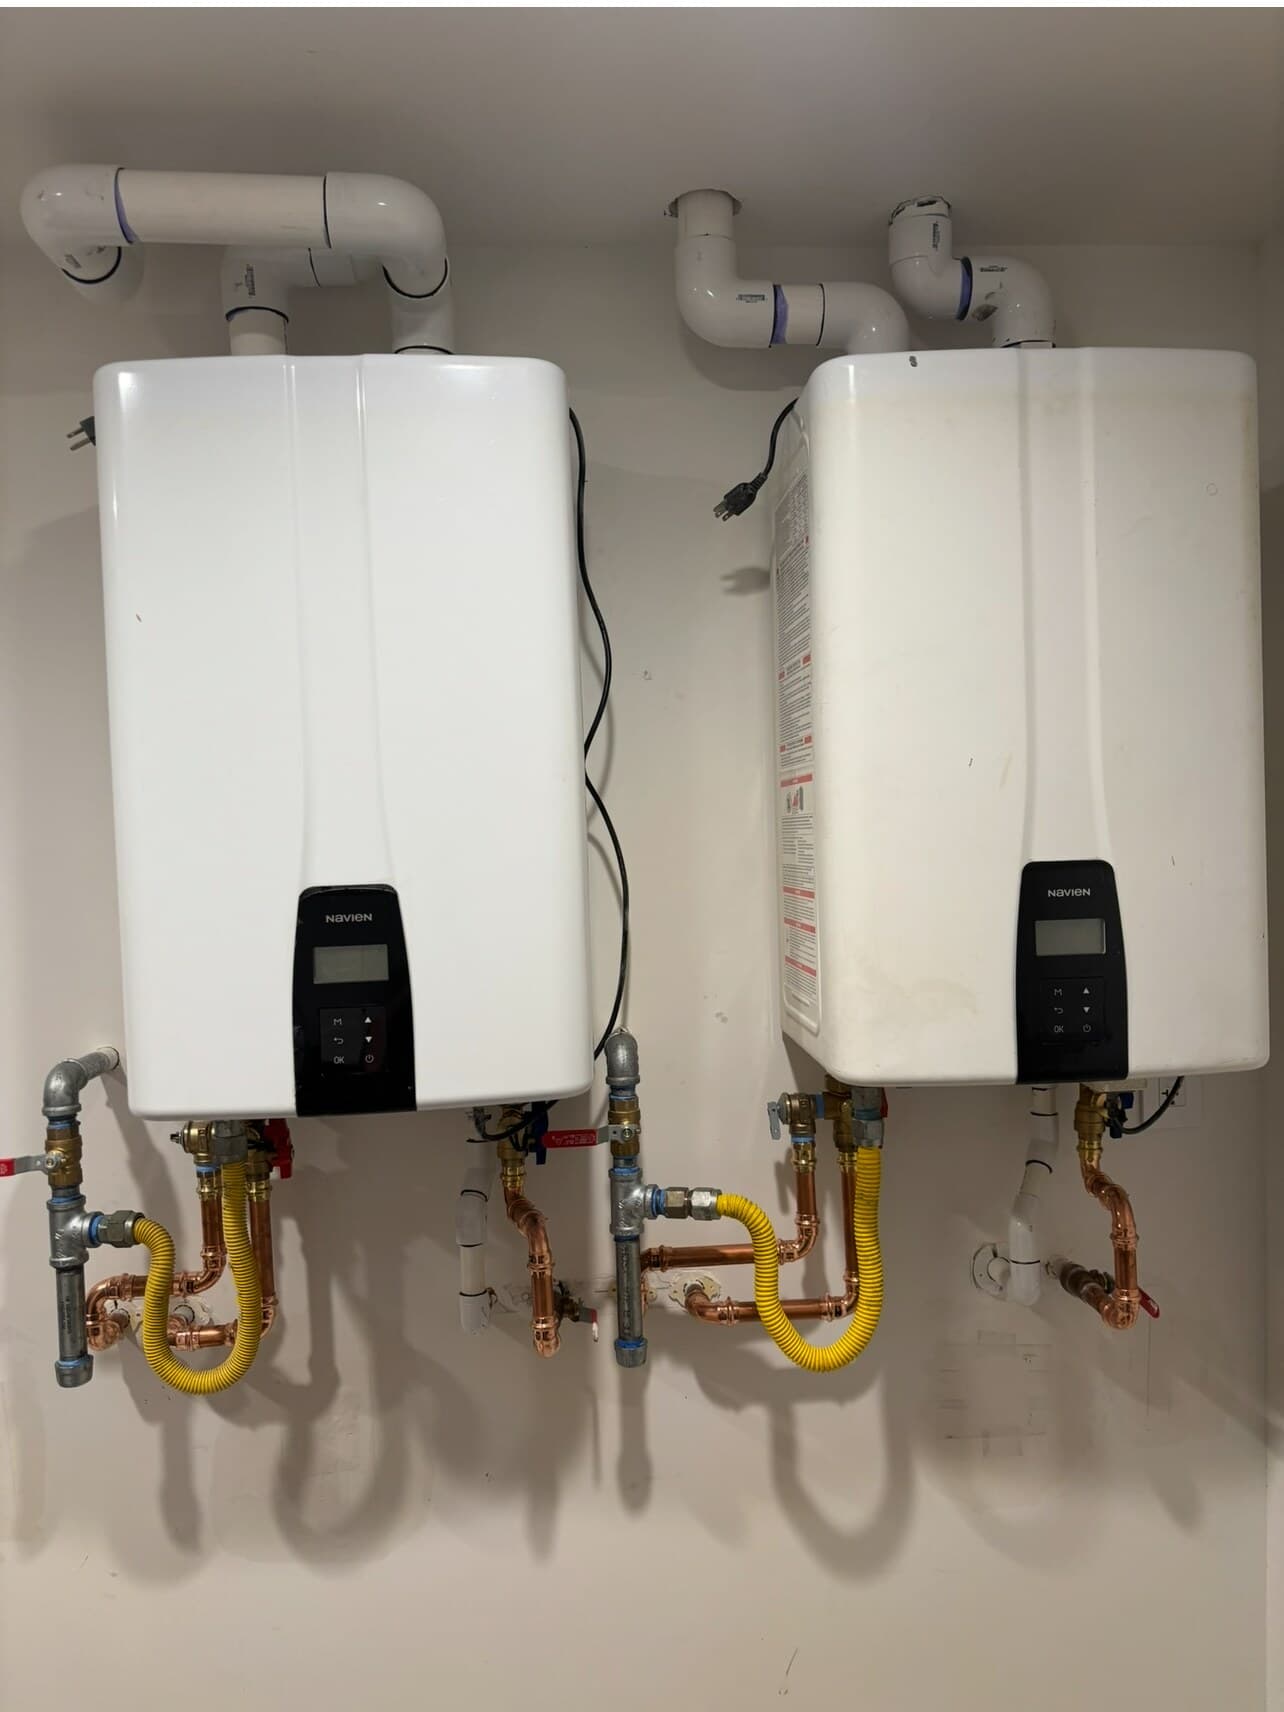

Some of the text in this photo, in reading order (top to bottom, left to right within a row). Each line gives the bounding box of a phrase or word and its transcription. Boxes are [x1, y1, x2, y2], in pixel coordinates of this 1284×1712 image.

[1054, 988, 1063, 996] M
[333, 1018, 342, 1026] M
[1053, 1025, 1064, 1033] OK
[333, 1056, 345, 1065] OK
